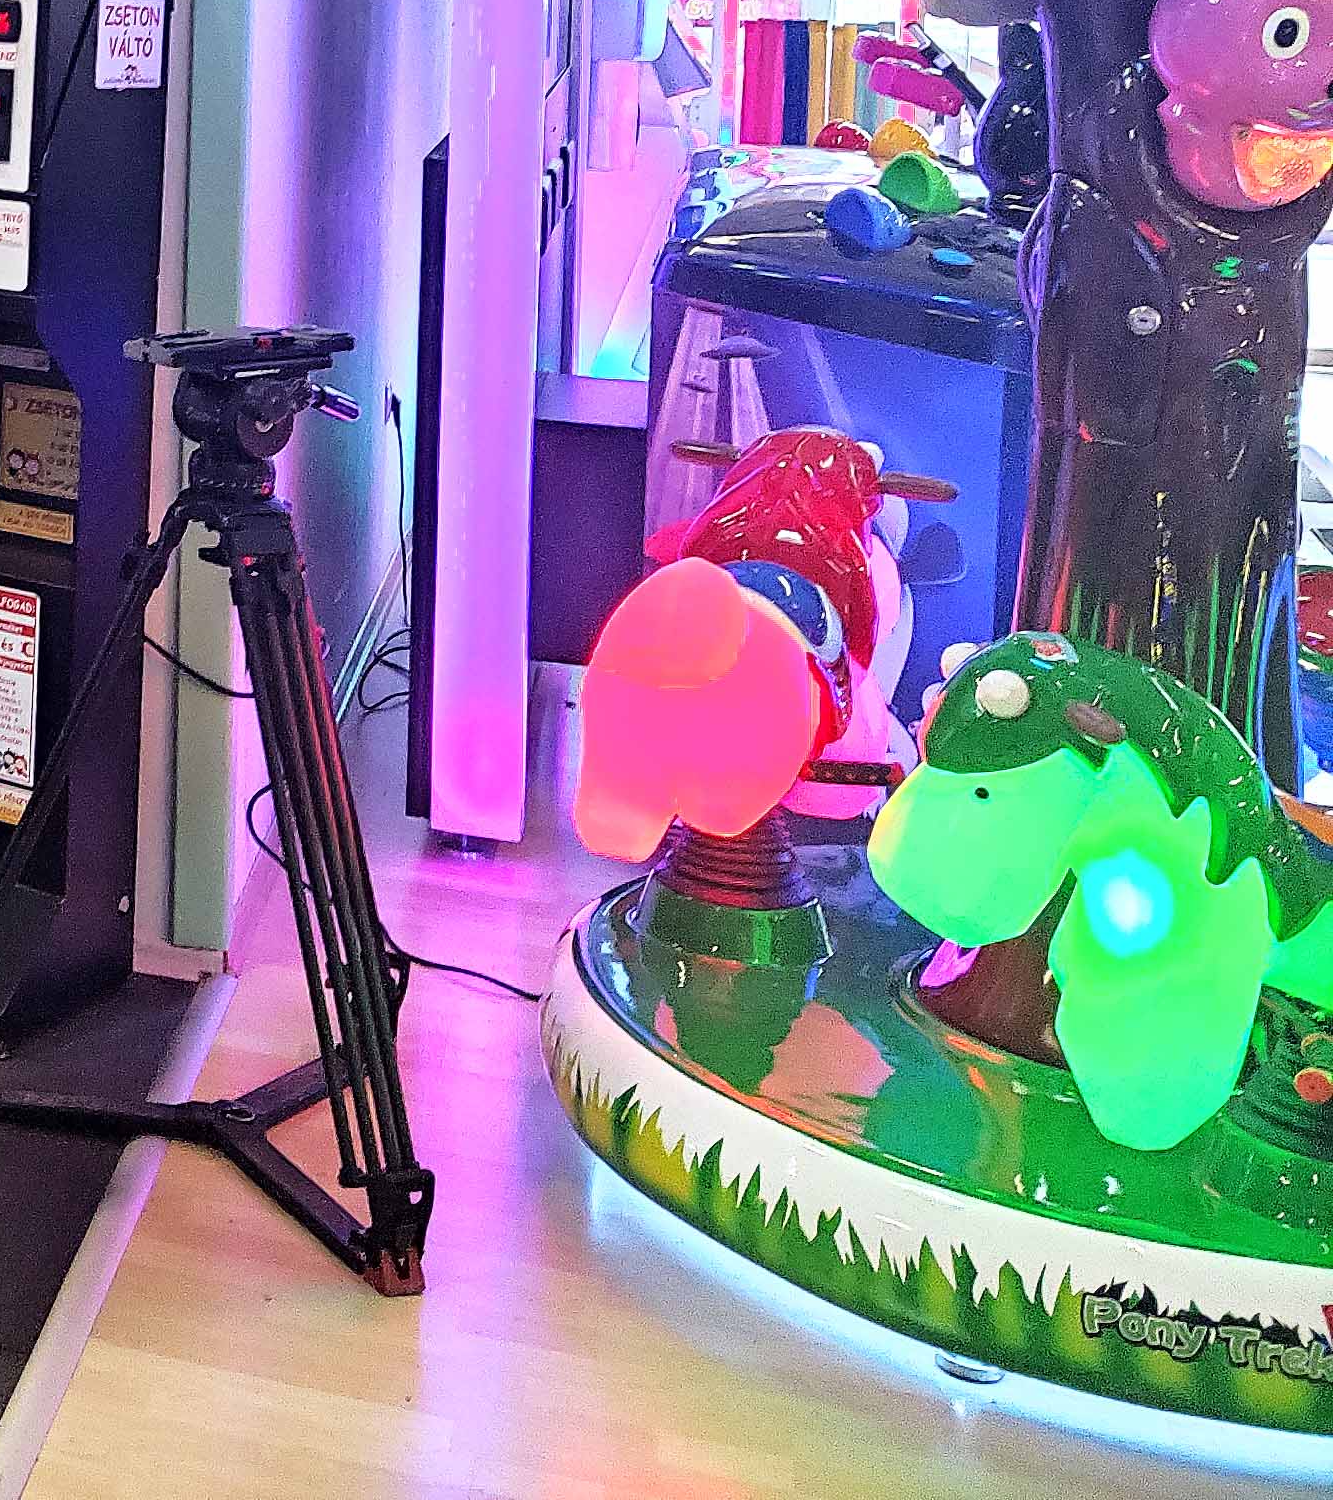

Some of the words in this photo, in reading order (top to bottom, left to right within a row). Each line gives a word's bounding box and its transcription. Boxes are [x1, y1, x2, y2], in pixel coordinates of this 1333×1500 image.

[104, 5, 161, 28] ZSETON
[109, 29, 154, 60] VÁLTÓ
[1081, 1293, 1209, 1363] Pony
